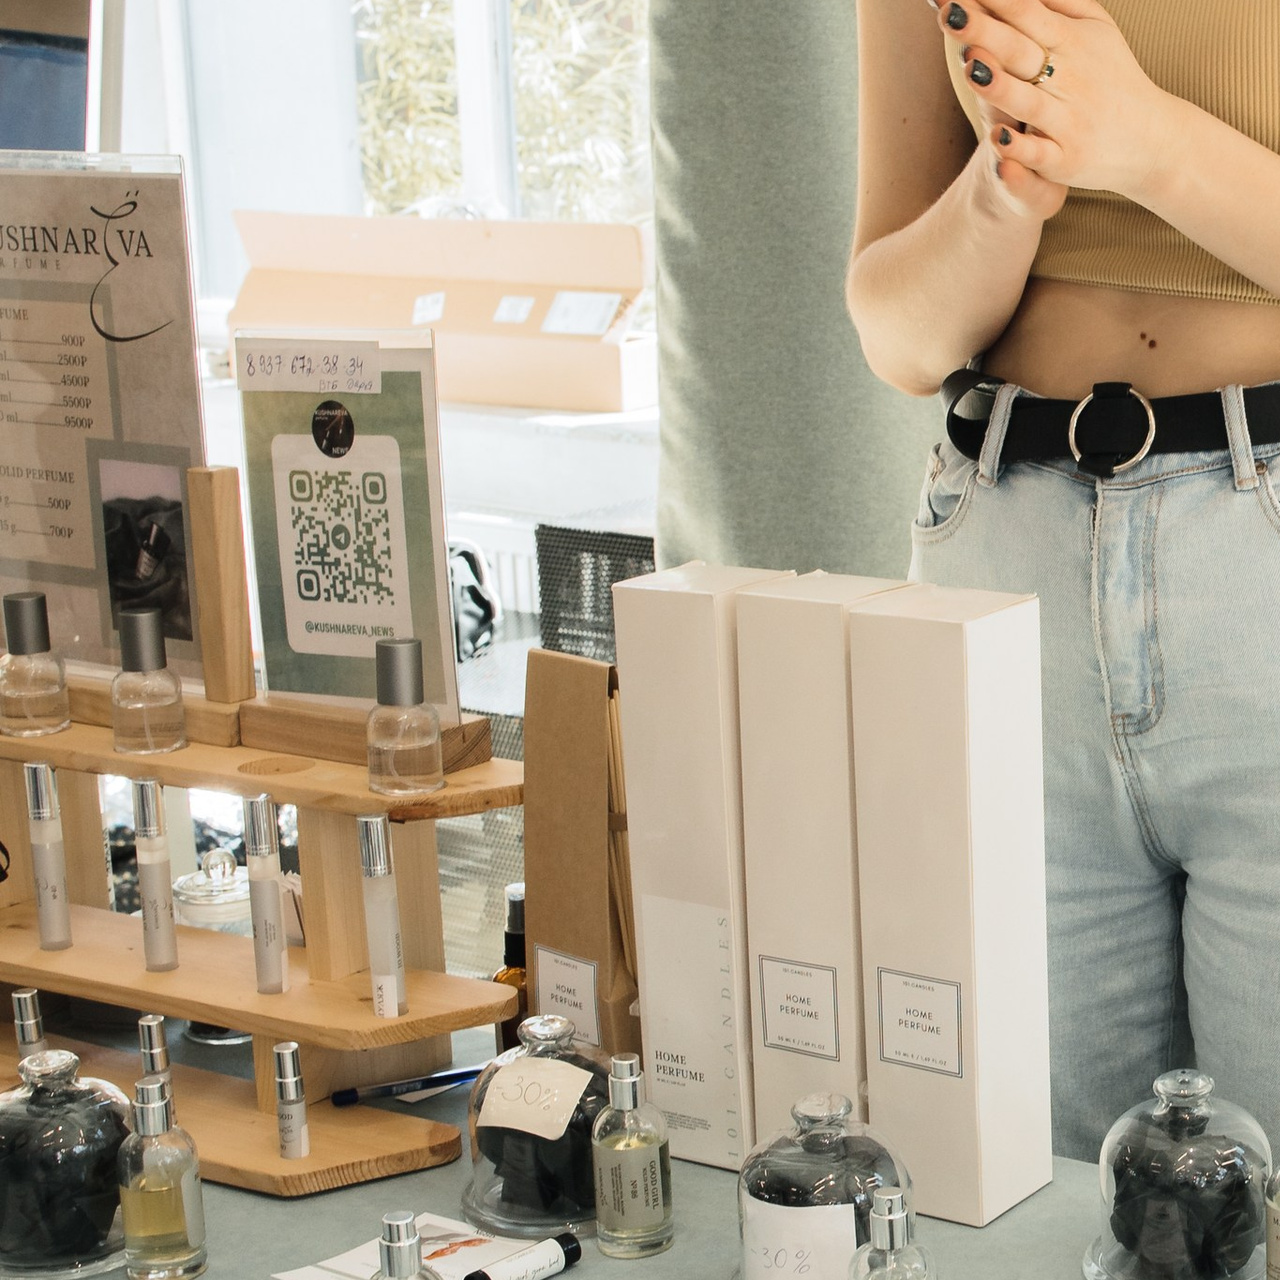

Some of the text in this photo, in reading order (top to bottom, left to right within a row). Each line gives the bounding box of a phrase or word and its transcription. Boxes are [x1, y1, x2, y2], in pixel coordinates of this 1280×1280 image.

[0, 465, 75, 484] OLID PERFUME
[304, 622, 395, 638] @KUSHNAREVA_NEWS
[555, 982, 577, 997] HOME
[550, 993, 584, 1011] PERFUME
[785, 993, 812, 1006] HOME
[779, 1004, 820, 1021] PERFUME
[905, 1007, 933, 1021] HOME
[898, 1018, 942, 1036] PERFUME
[655, 1049, 687, 1066] HOME
[656, 1064, 706, 1083] PERFUME
